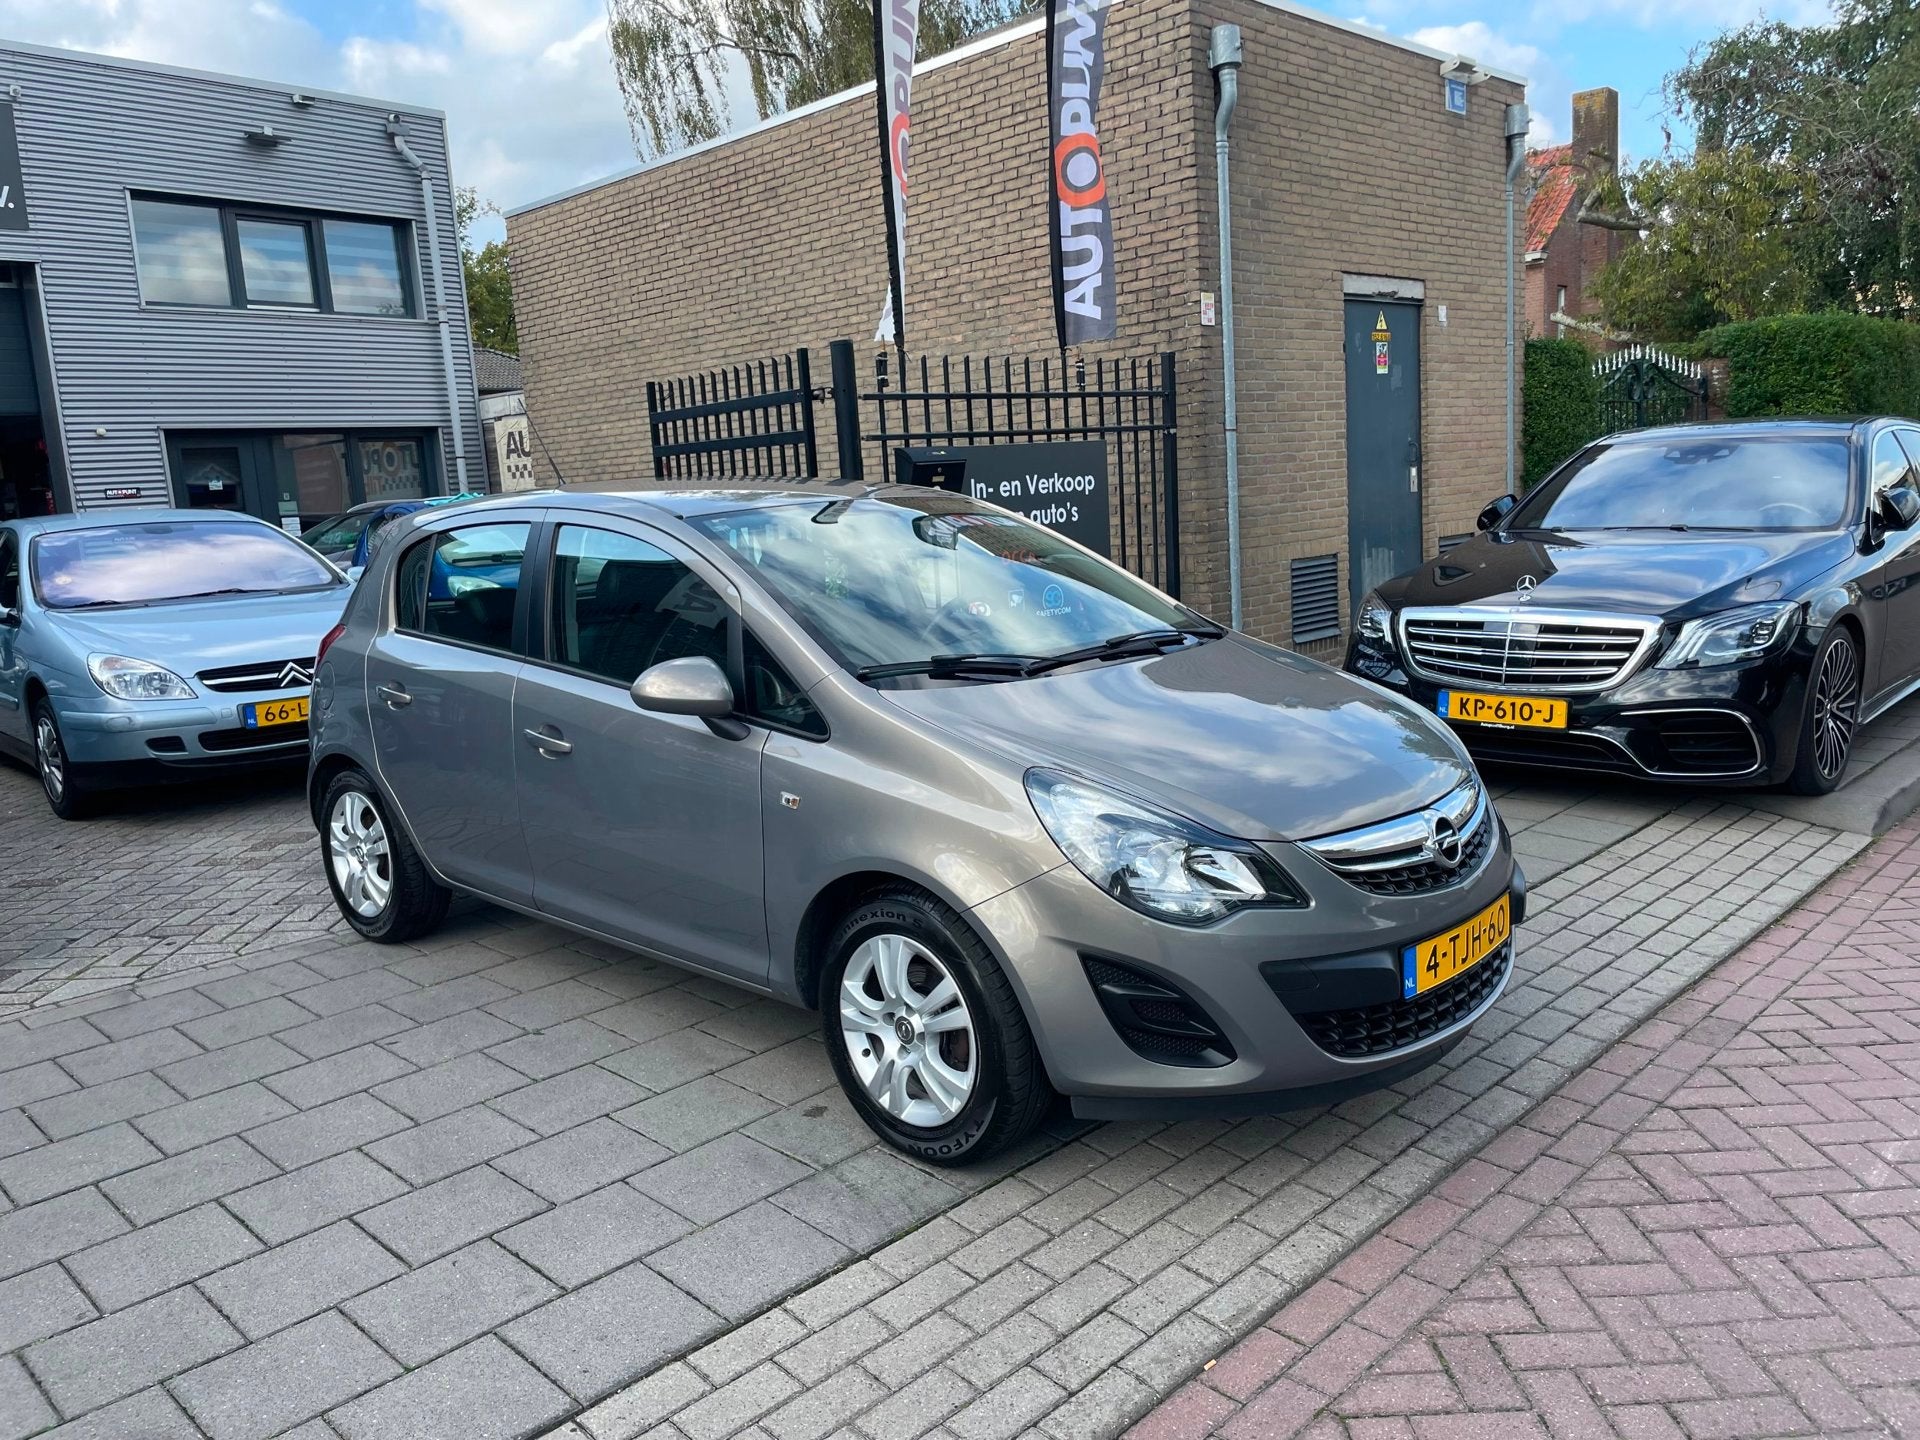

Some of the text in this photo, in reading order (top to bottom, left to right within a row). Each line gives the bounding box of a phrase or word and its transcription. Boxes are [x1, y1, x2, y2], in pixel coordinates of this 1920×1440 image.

[1055, 0, 1106, 320] AUTOPUN
[971, 473, 1095, 498] In- en Verkoop
[1030, 502, 1079, 524] auto's
[1459, 697, 1554, 723] KP-610-J
[1426, 904, 1505, 979] 4-TJH-60
[1405, 977, 1415, 990] NL
